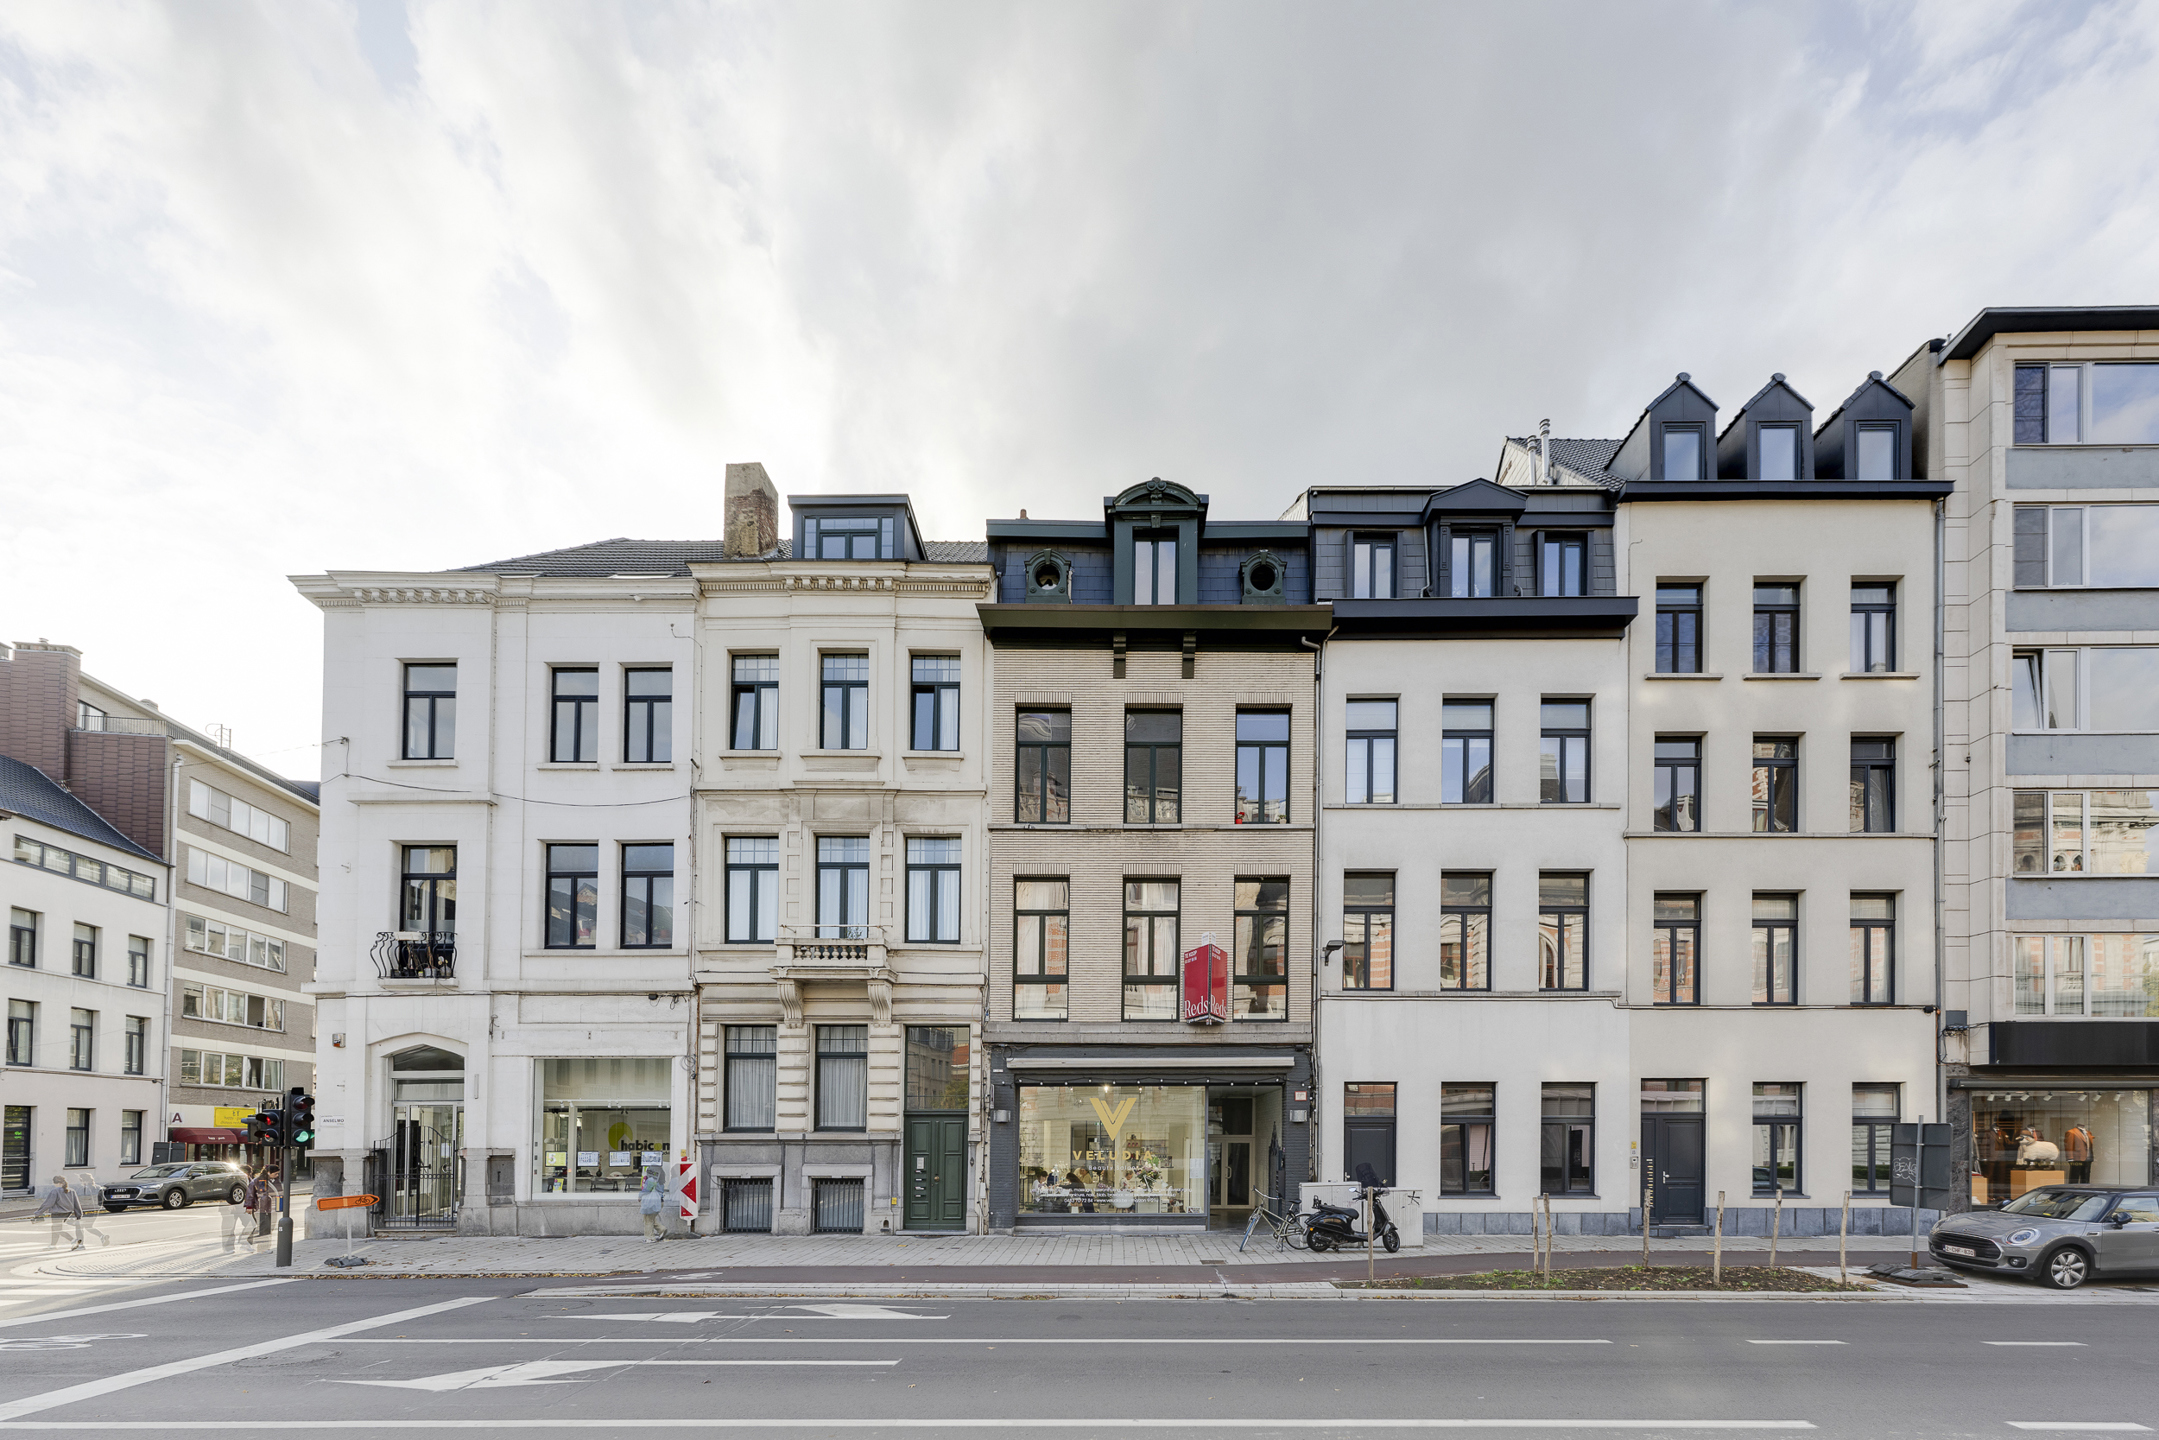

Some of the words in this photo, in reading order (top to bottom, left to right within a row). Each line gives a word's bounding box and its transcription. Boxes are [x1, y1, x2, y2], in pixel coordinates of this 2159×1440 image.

[1184, 996, 1209, 1018] Reds
[1210, 994, 1227, 1018] Reds
[172, 1112, 182, 1123] A
[1072, 1150, 1153, 1160] VELUDIA
